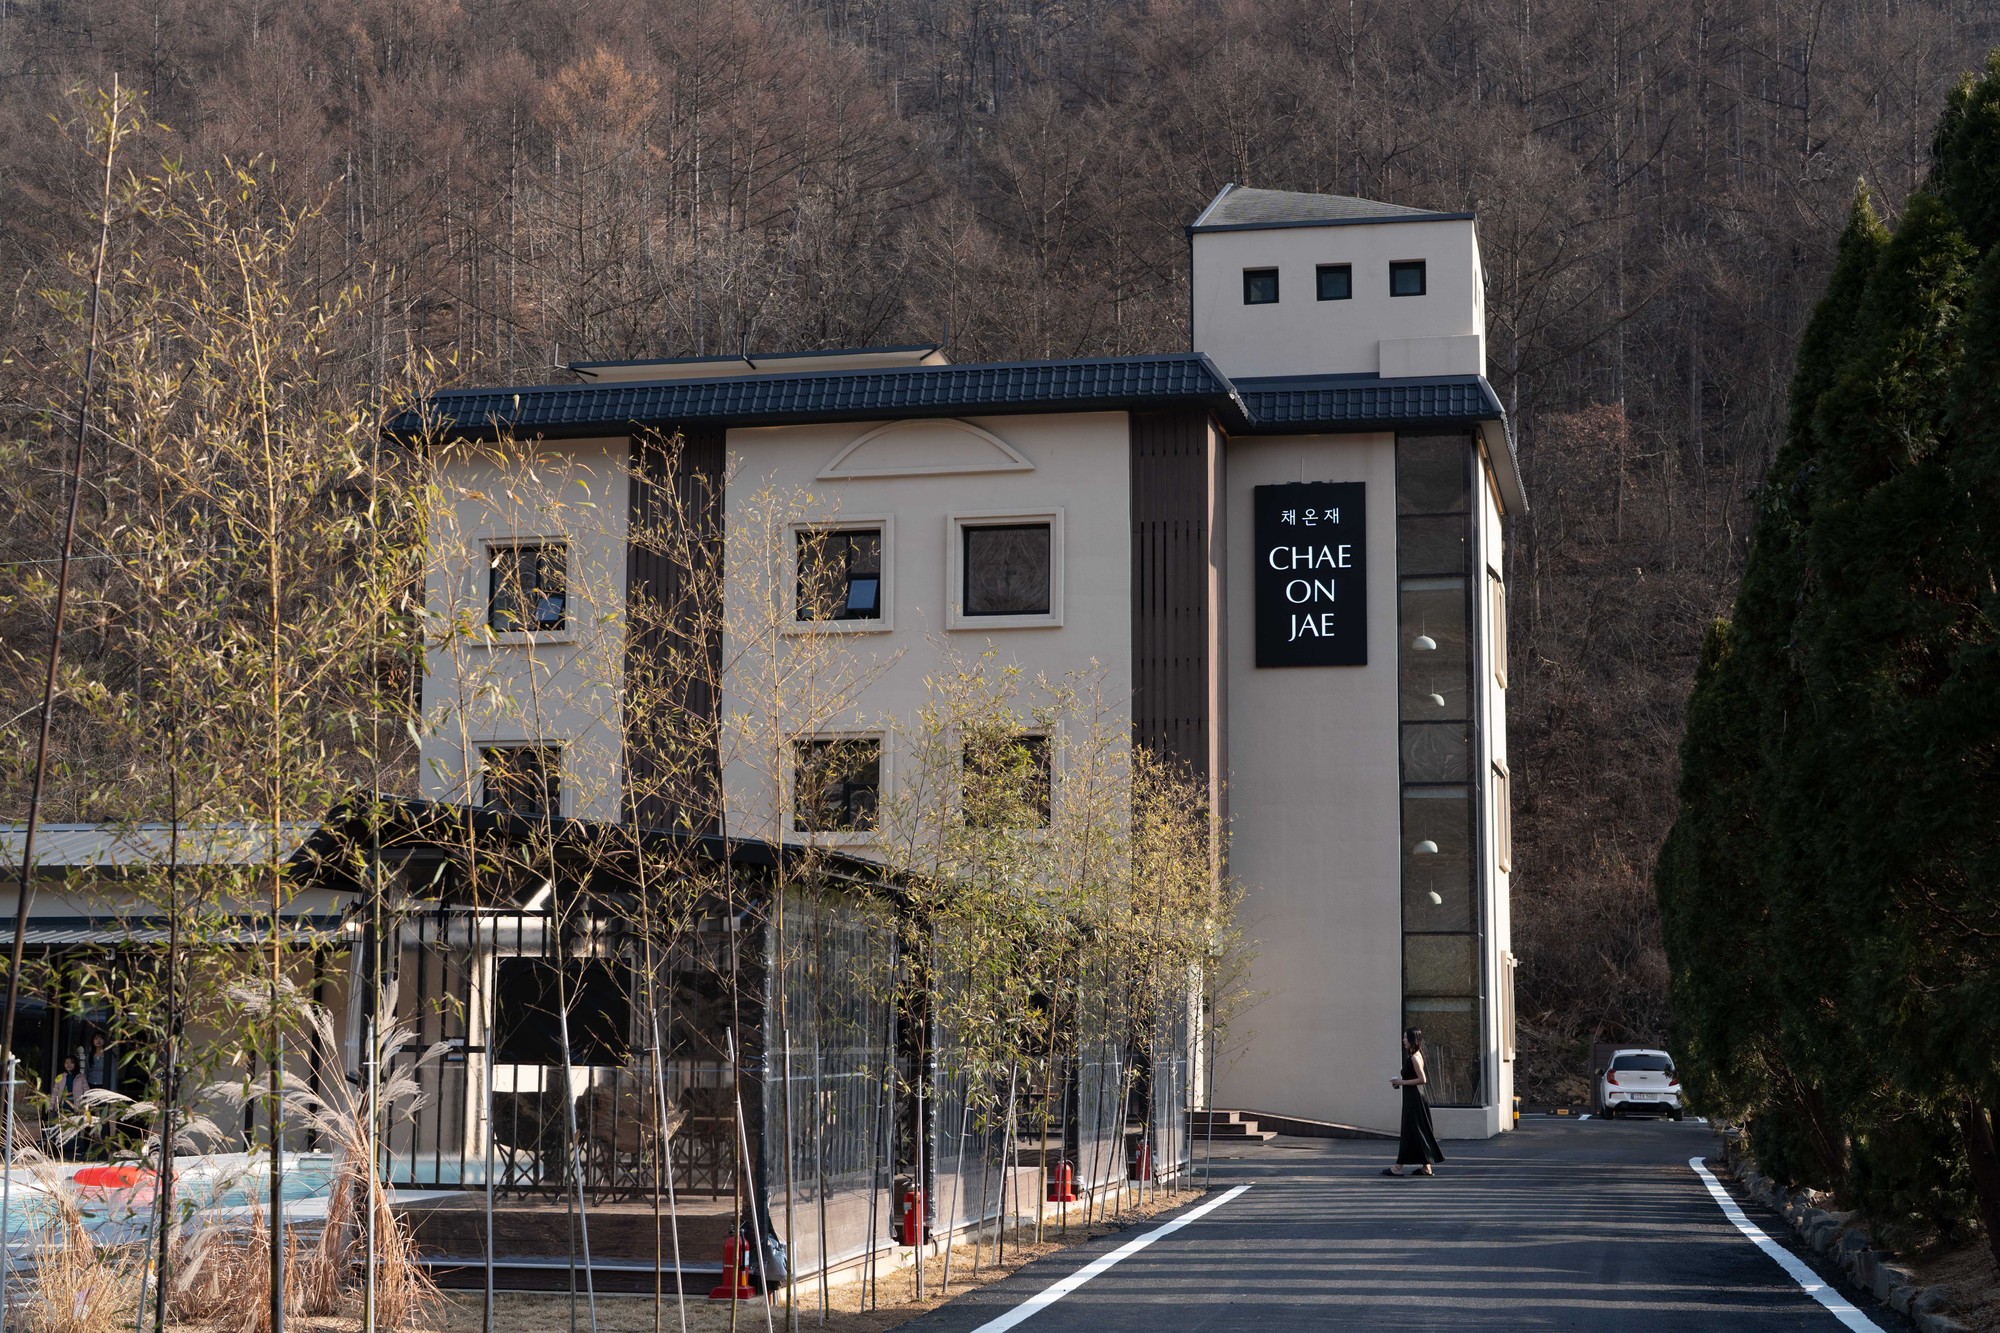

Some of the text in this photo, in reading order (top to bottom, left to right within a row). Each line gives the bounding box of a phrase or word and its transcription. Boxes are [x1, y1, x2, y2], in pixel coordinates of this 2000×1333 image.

[1268, 544, 1352, 571] CHAE
[1285, 578, 1335, 604] ON
[1288, 613, 1335, 642] JAE
